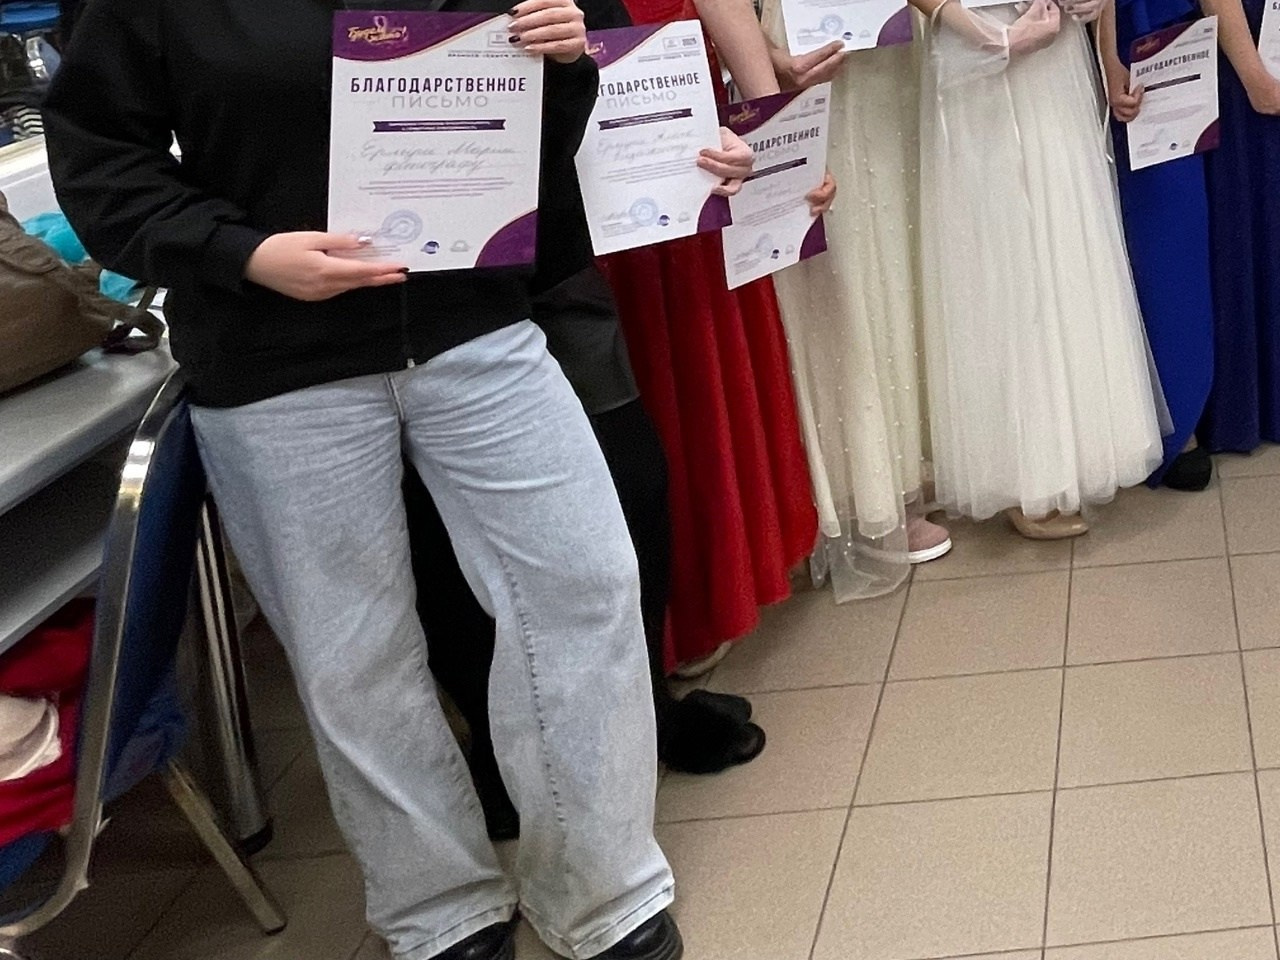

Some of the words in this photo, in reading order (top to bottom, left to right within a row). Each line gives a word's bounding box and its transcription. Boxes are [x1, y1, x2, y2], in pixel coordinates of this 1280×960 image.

[1136, 49, 1210, 77] БЛАГОДАРСТВЕННОЕ
[350, 77, 527, 94] БЛАГОДАРСТВЕННОЕ
[597, 72, 701, 97] ГОДАРСТВЕННОЕ
[391, 95, 489, 109] ПИСЬМО
[606, 90, 677, 109] ПИСЬМО
[748, 126, 820, 152] ОДАРСТВЕННОЕ
